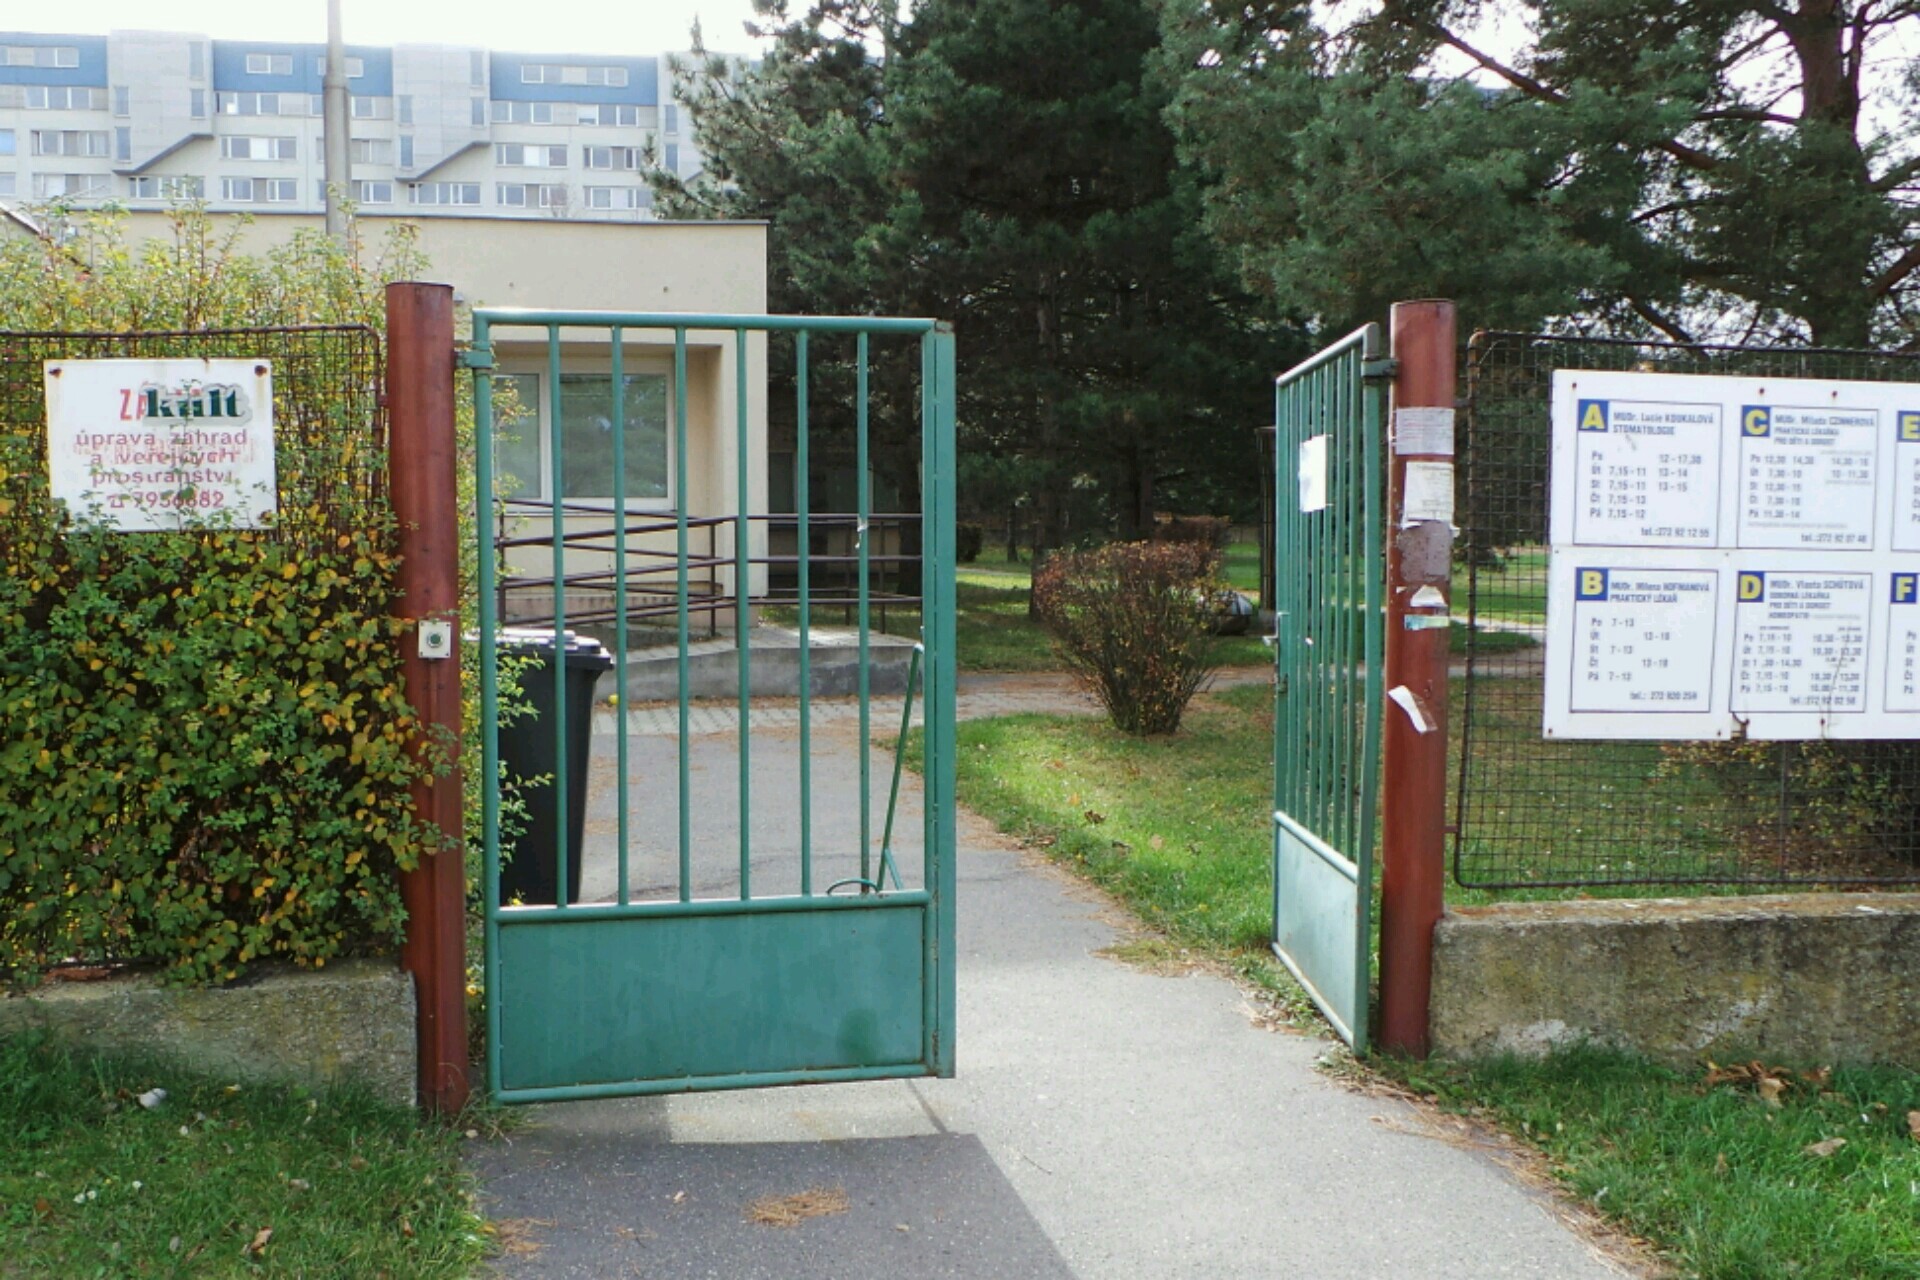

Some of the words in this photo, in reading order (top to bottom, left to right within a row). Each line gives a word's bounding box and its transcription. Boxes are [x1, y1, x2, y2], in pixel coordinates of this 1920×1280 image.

[1582, 403, 1605, 429] A
[1745, 409, 1768, 435] C
[76, 429, 156, 449] úprava
[1582, 570, 1603, 595] B
[1740, 575, 1762, 599] D
[1896, 576, 1914, 601] F
